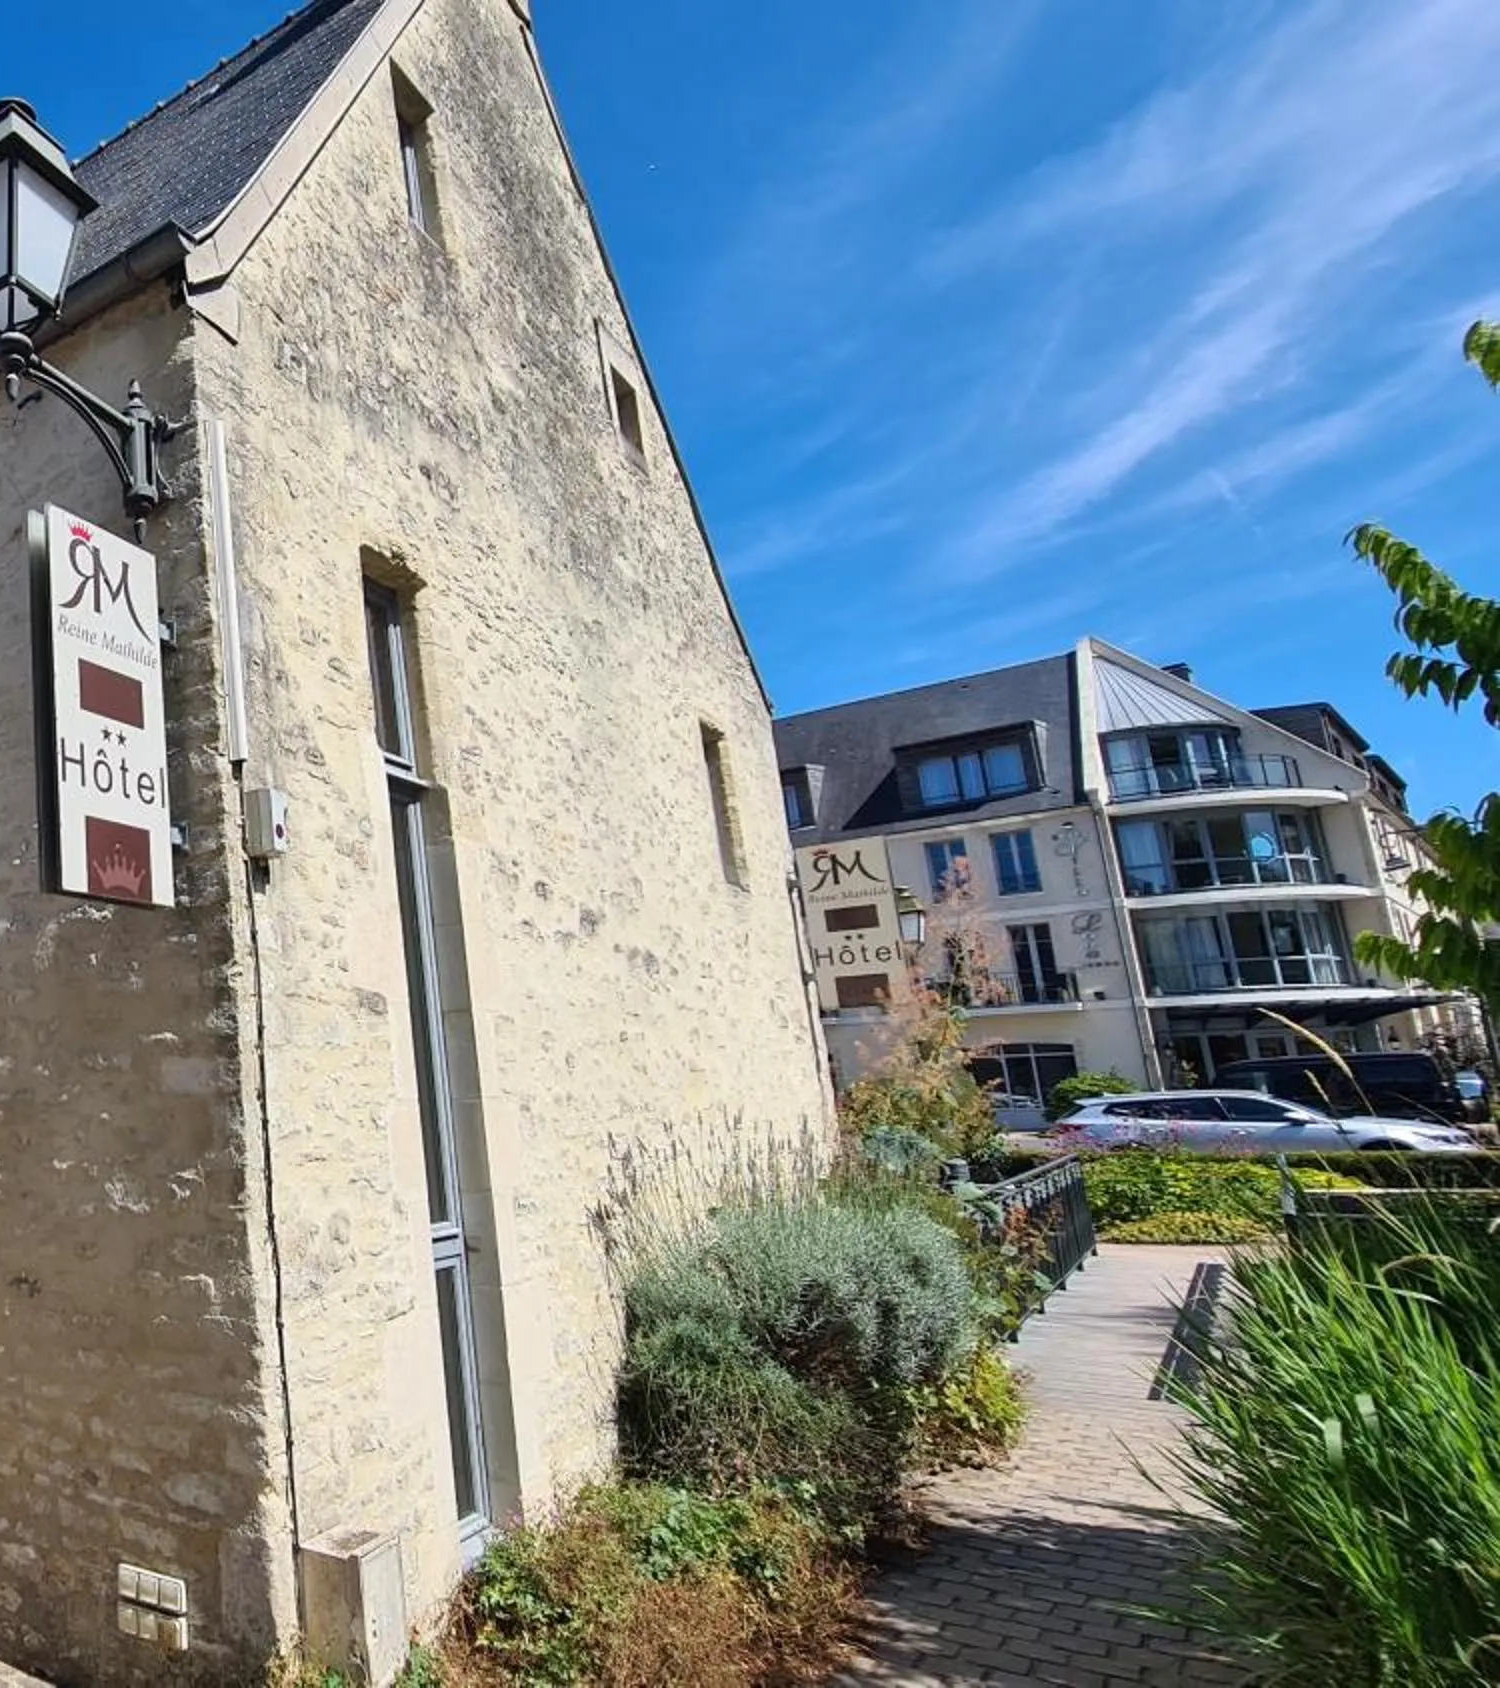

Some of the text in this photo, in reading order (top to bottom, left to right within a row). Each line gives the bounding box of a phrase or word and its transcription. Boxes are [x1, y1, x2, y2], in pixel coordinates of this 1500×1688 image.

[57, 613, 159, 670] Reine Mathilde
[60, 737, 166, 810] Hôtel
[814, 939, 904, 967] Hôtel
